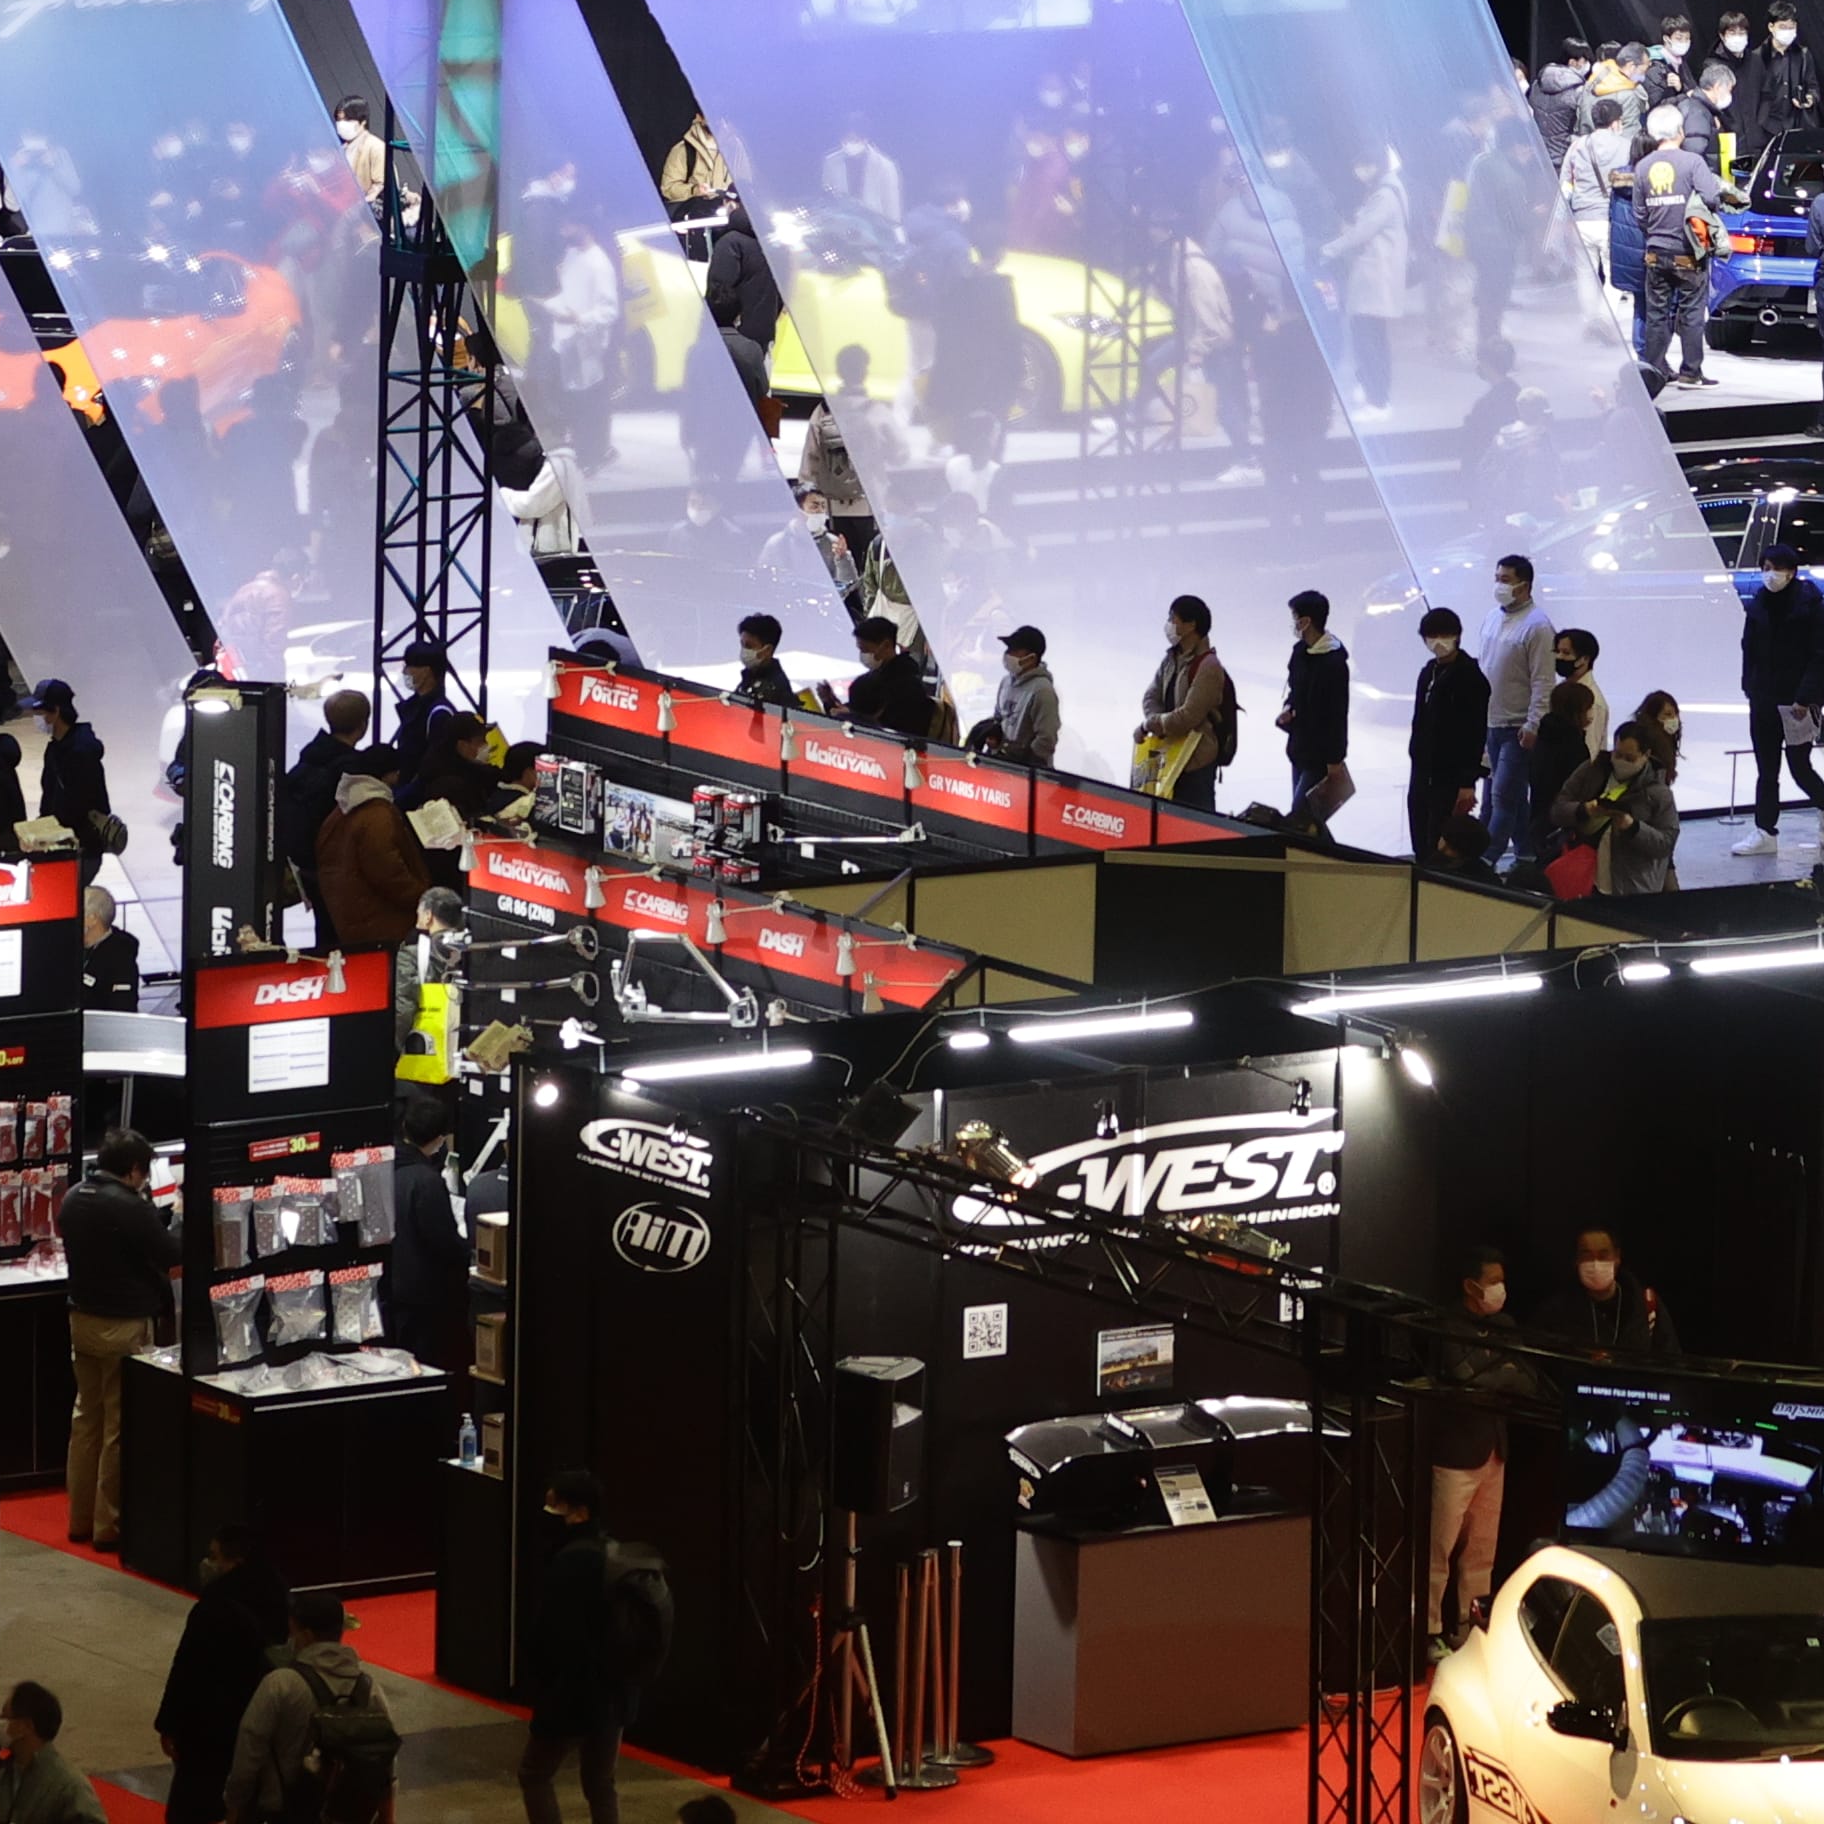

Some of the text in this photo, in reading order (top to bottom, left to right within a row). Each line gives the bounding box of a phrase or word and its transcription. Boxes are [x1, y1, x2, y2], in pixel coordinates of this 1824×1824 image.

[928, 773, 944, 791] GR
[944, 779, 974, 800] YARIS
[981, 786, 1012, 809] YARIS
[217, 782, 236, 869] CARBING
[1074, 806, 1125, 834] CARBING
[497, 894, 513, 914] GR
[514, 898, 528, 917] 86
[636, 890, 689, 920] CARBING
[758, 928, 805, 958] DASH
[253, 978, 326, 1006] DASH
